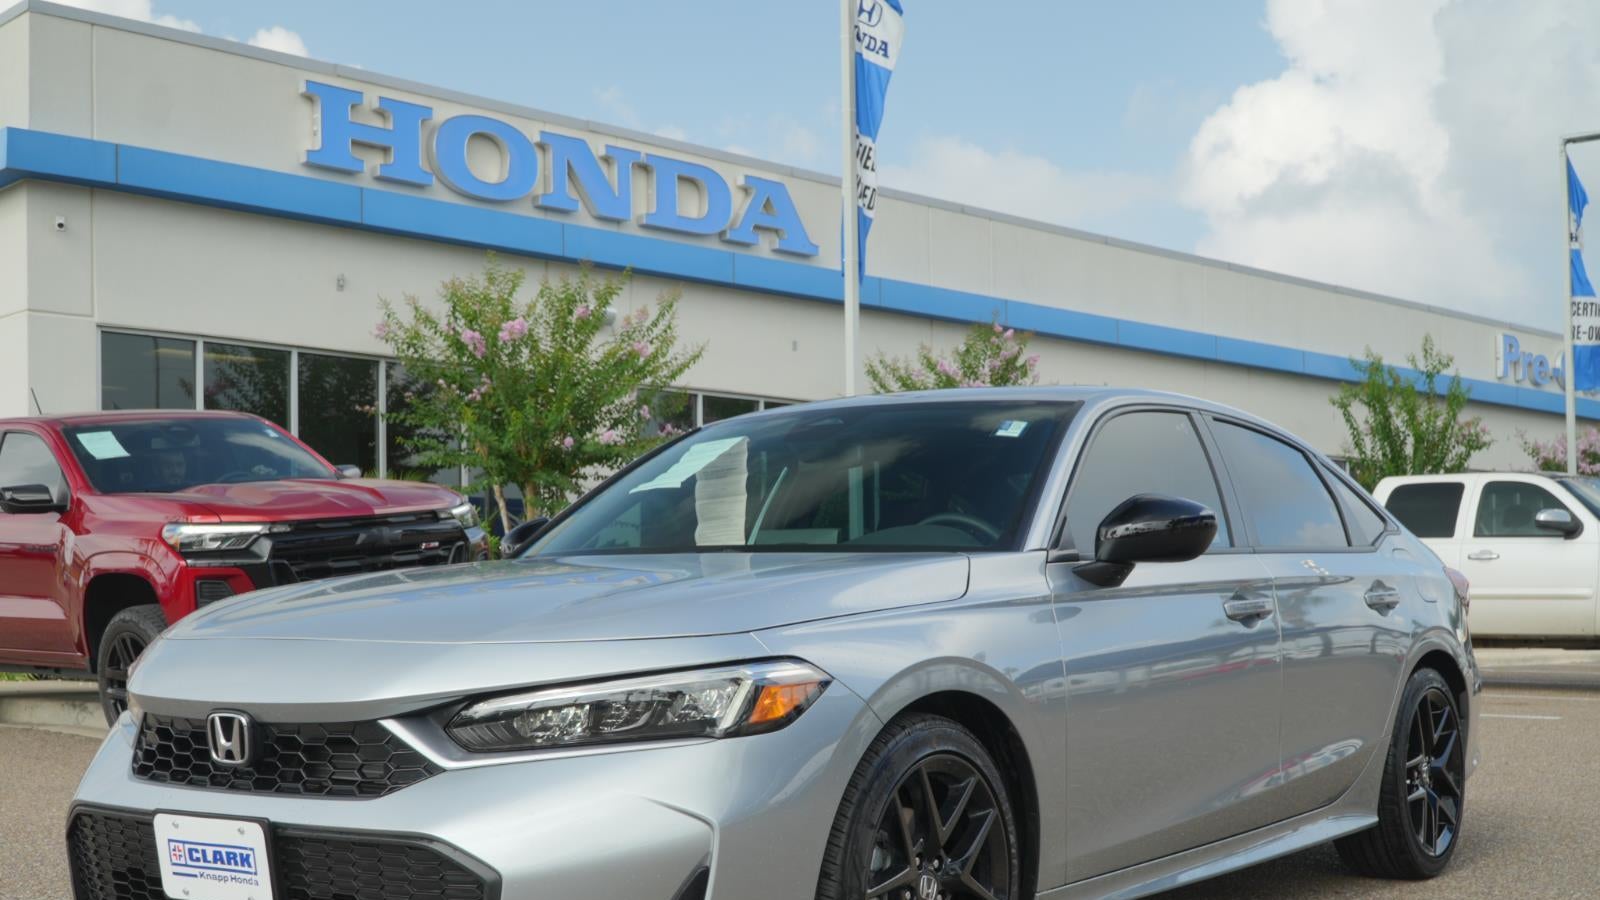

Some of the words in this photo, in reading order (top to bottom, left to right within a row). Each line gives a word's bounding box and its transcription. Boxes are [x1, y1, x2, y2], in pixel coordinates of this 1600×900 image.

[854, 25, 890, 59] NDA
[301, 79, 819, 257] HONDA
[1571, 301, 1600, 317] CERTI
[1497, 333, 1566, 391] Pre-
[187, 847, 252, 869] CLARK
[199, 871, 229, 883] Knapp
[230, 874, 259, 886] Honda
